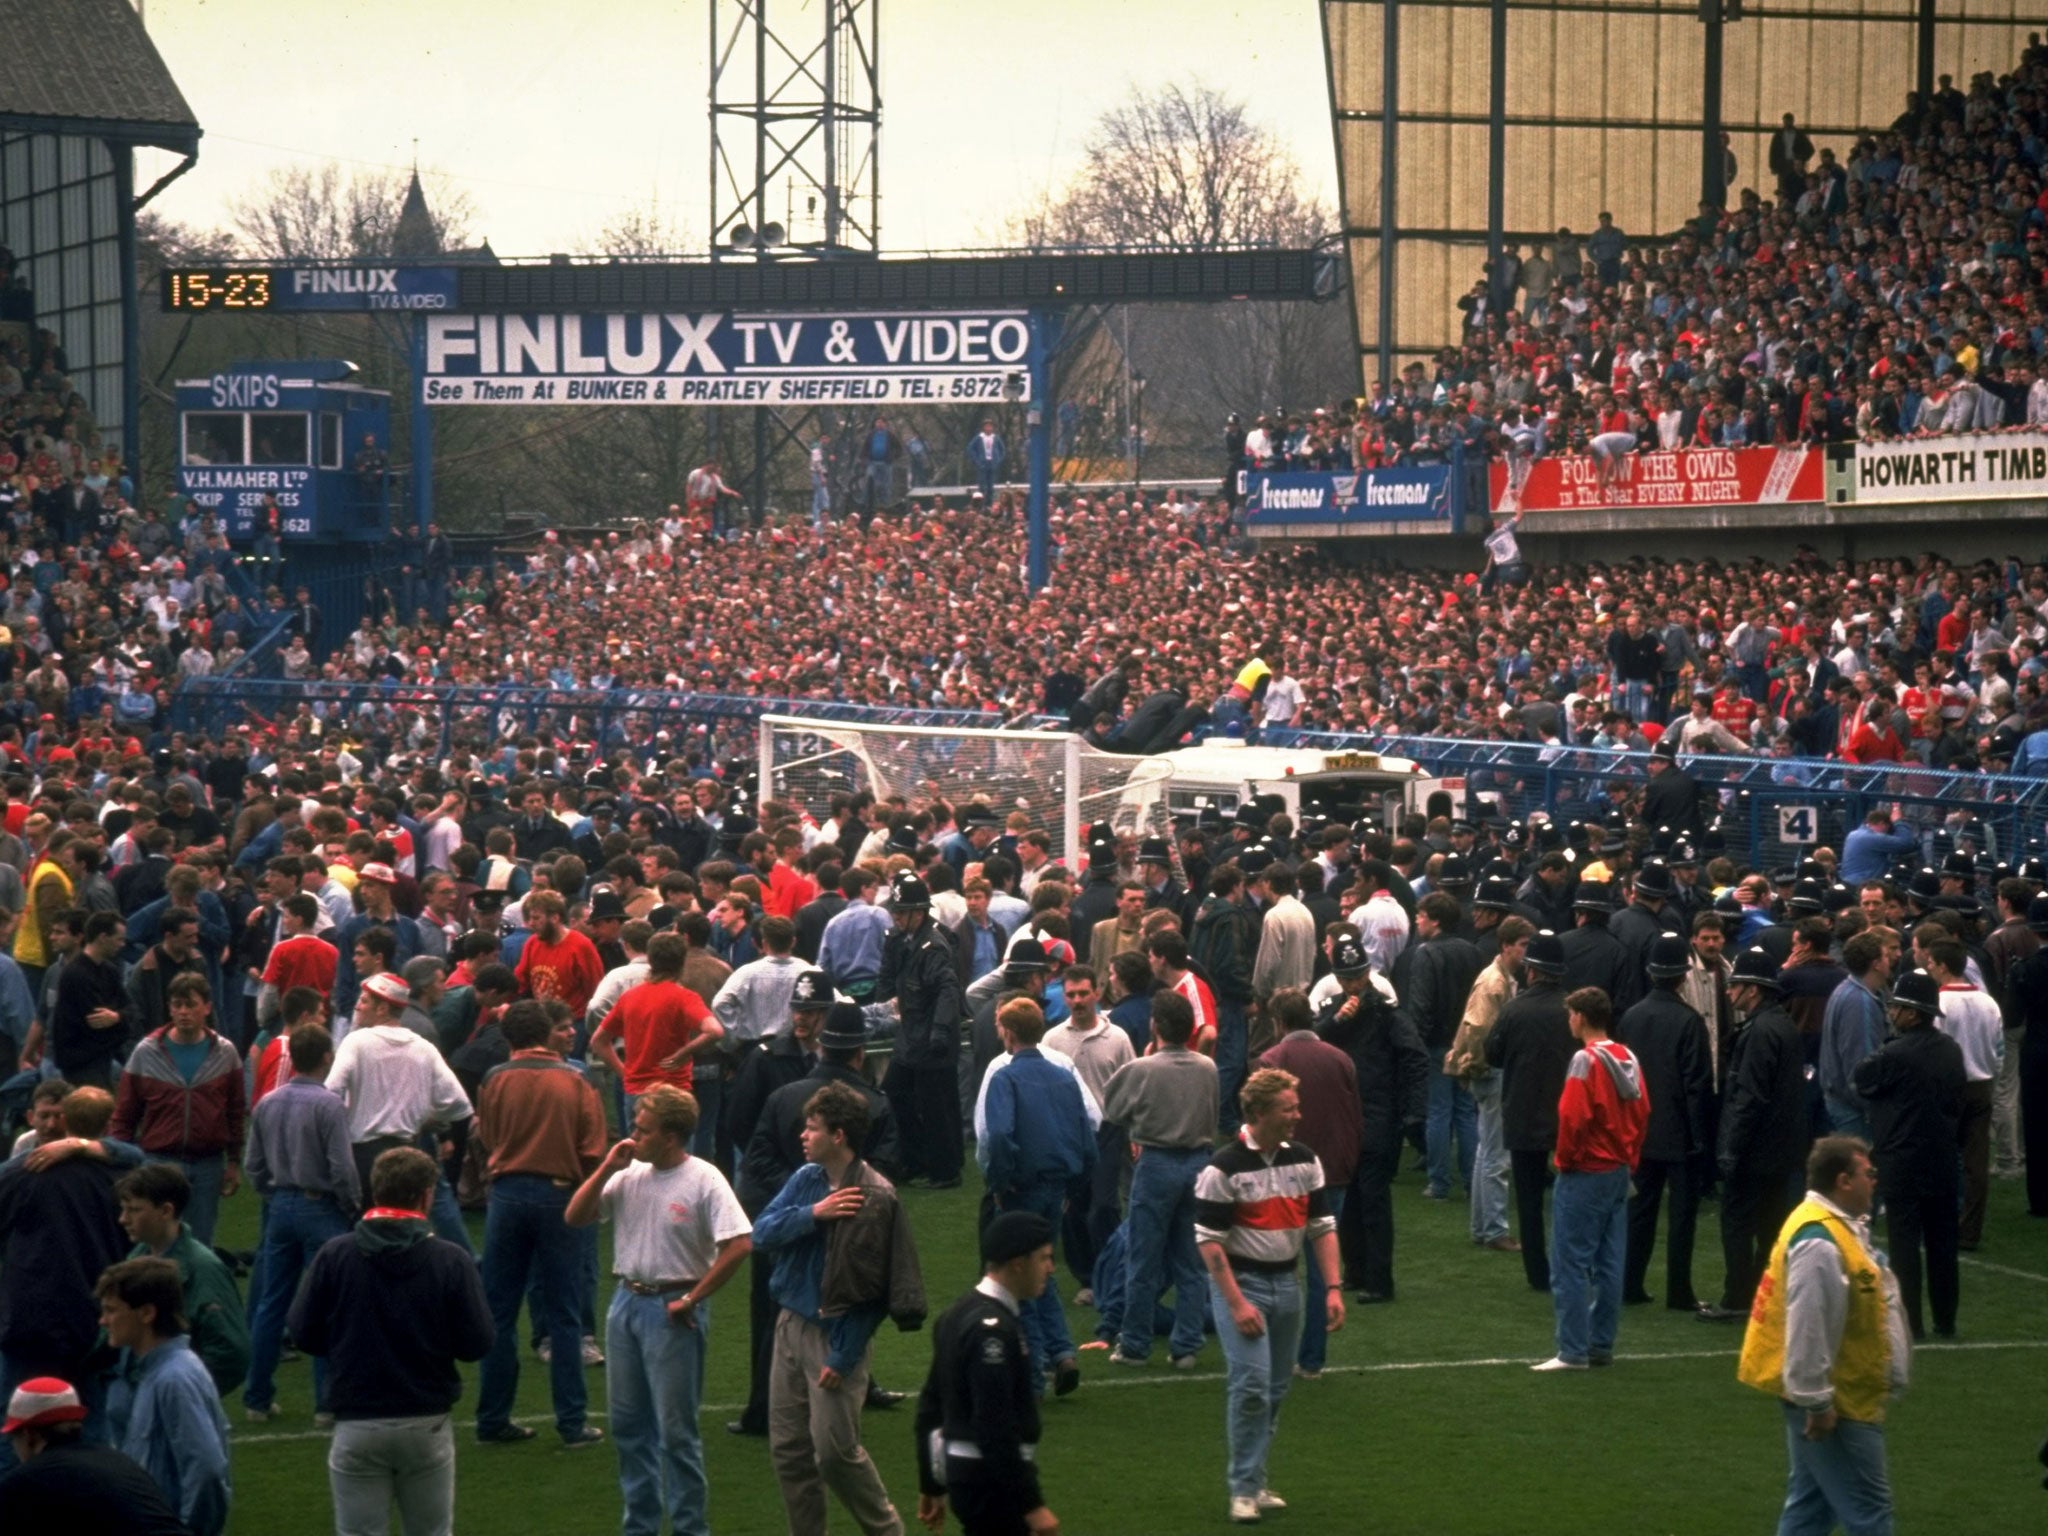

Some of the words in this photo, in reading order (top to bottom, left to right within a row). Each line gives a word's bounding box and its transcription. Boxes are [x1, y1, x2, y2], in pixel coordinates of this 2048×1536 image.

[173, 274, 268, 306] 15-23
[294, 269, 398, 293] FINLUX
[369, 295, 390, 309] TV
[391, 295, 401, 309] &
[402, 294, 446, 308] VIDEO
[427, 314, 727, 375] FINLUX
[733, 321, 802, 363] TV
[824, 320, 857, 363] &
[875, 319, 1029, 362] VIDEO
[212, 375, 279, 407] SKIPS
[427, 380, 463, 400] See
[473, 380, 524, 400] Them
[567, 379, 648, 400] BUNKER
[653, 379, 667, 400] &
[682, 379, 770, 400] PRATLEY
[779, 379, 890, 400] SHEFFIELD
[1640, 455, 1678, 481] THE
[1686, 452, 1737, 480] OWLS
[1860, 451, 1976, 488] HOWARTH
[193, 493, 225, 507] SKIP
[1559, 492, 1574, 506] IN
[1605, 485, 1634, 504] Star
[1636, 482, 1686, 504] EVERY
[1691, 480, 1741, 501] NIGHT
[235, 507, 256, 517] TEL
[1785, 809, 1813, 840] 4
